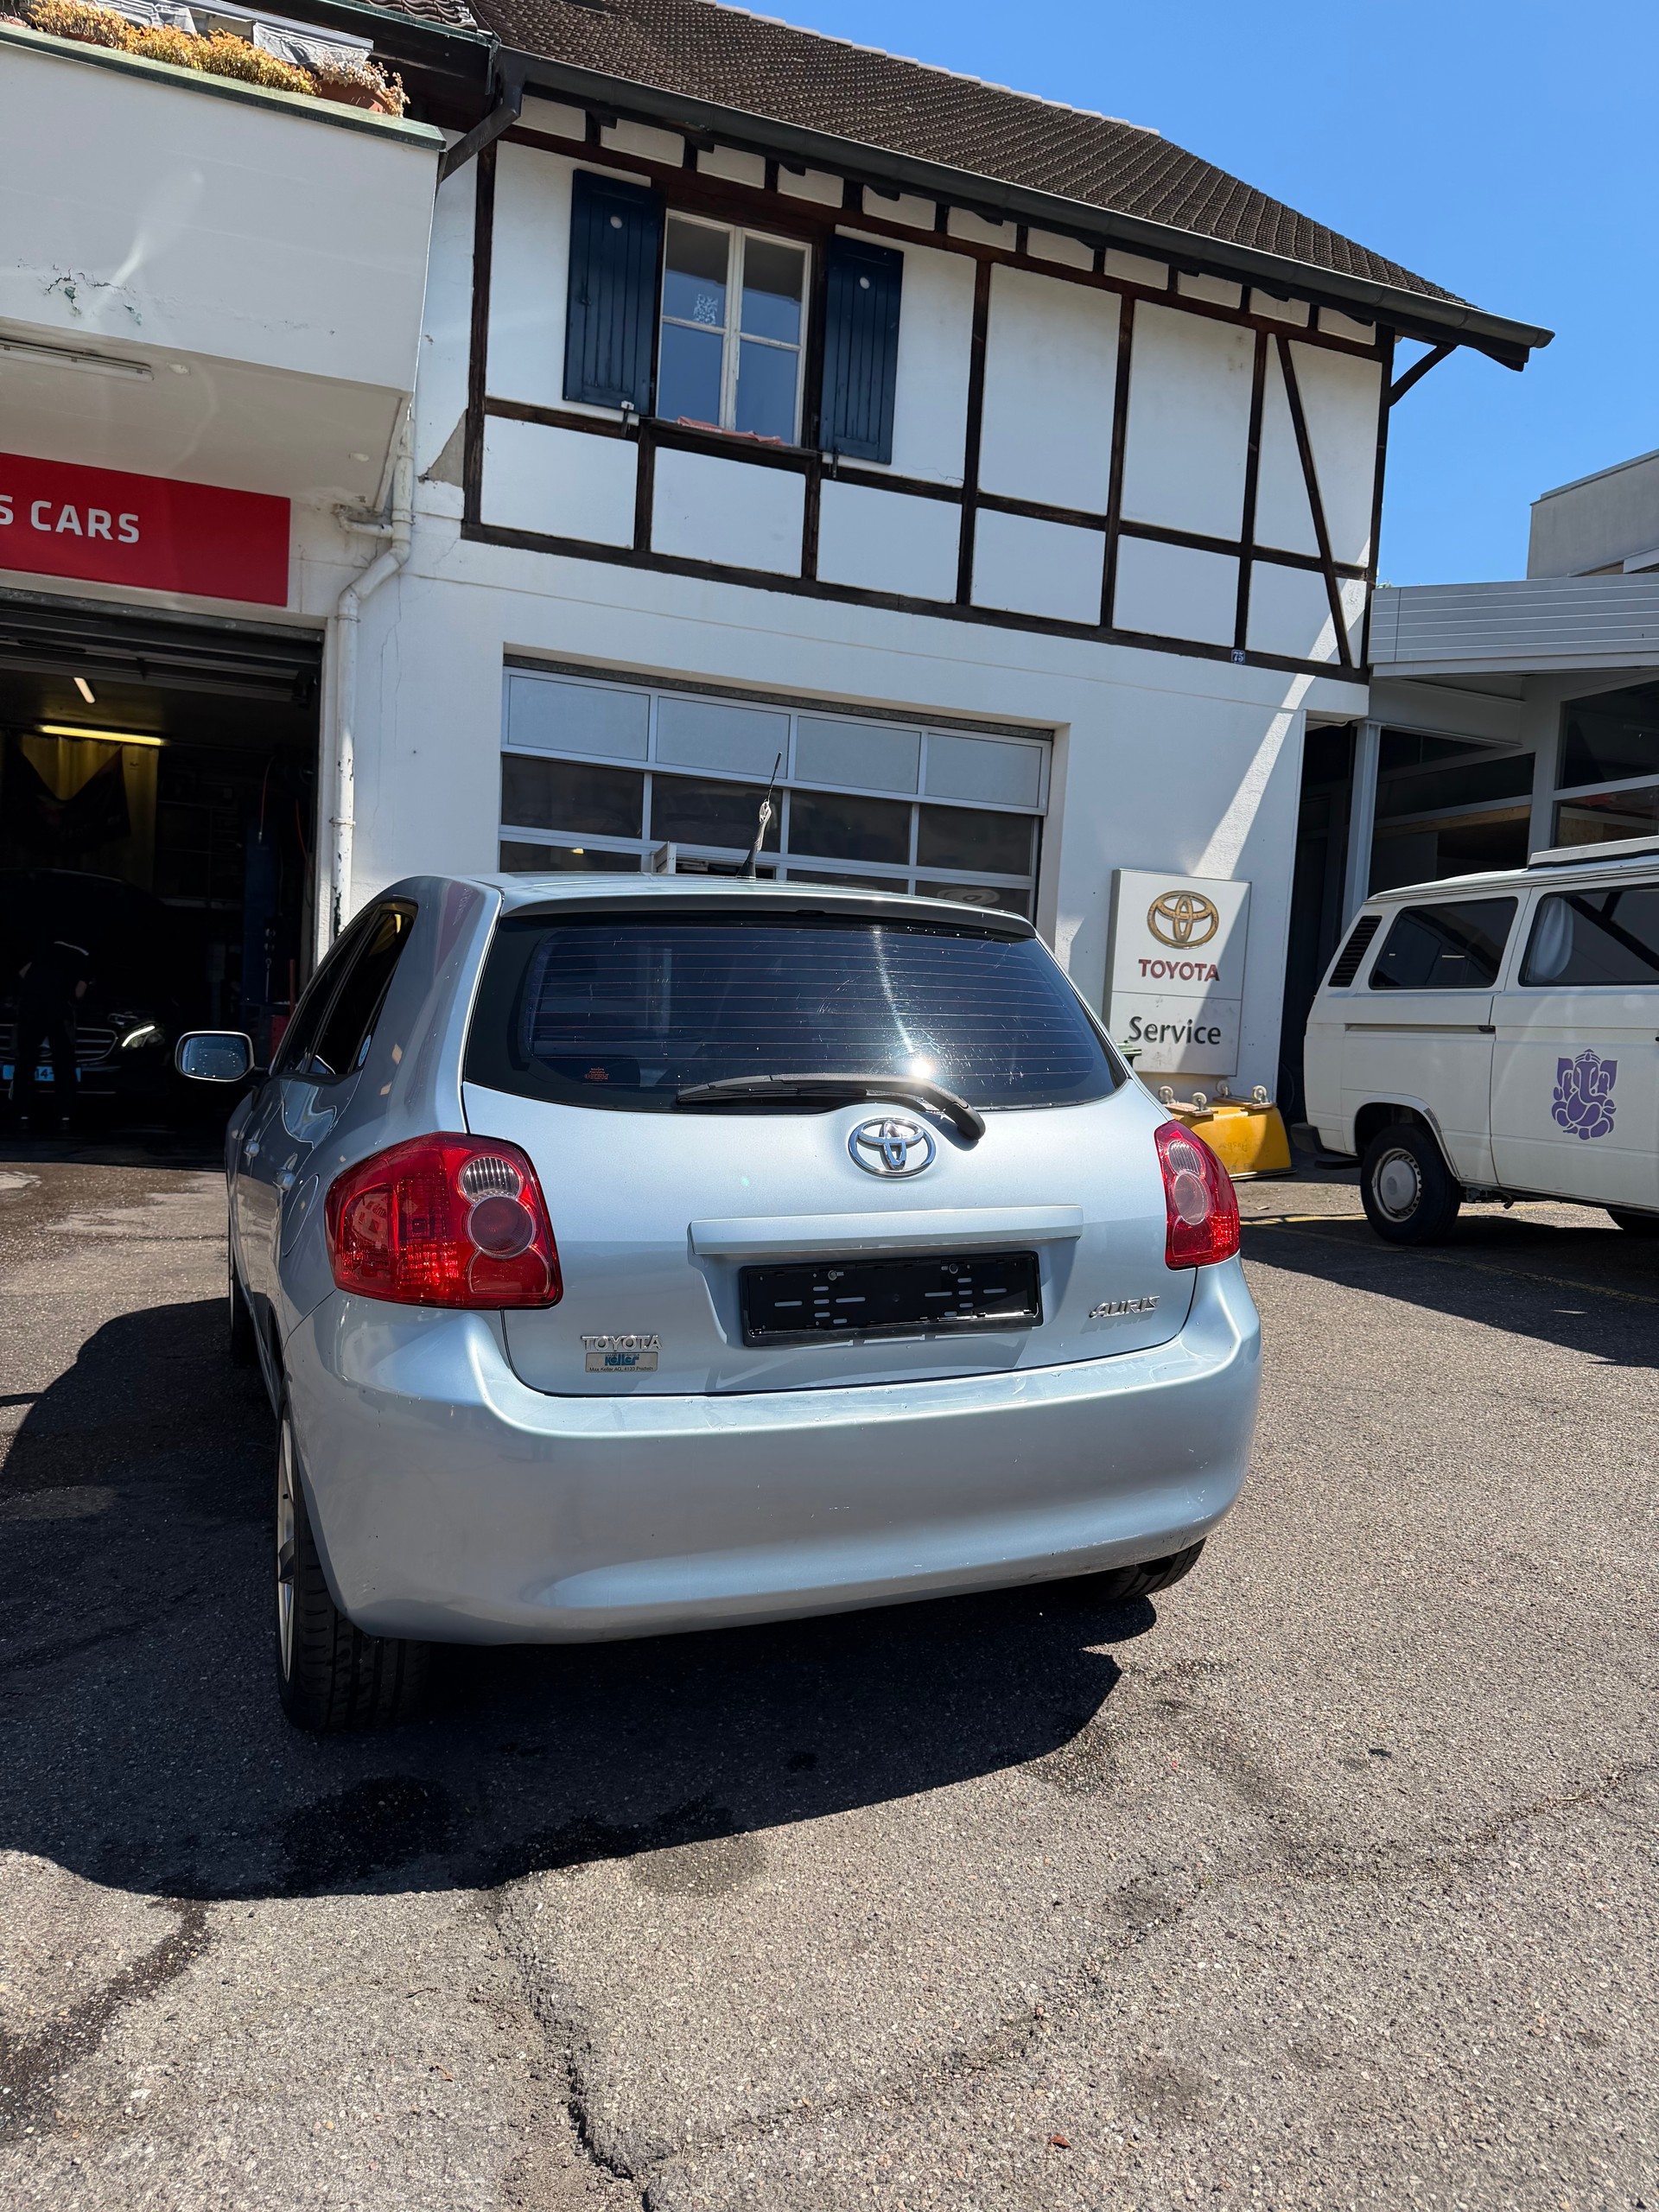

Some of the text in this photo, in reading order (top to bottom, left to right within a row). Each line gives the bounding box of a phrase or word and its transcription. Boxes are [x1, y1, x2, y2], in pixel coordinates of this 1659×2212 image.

[30, 500, 139, 543] CARS
[1233, 651, 1243, 663] 75
[1138, 958, 1220, 982] TOYOTA
[1128, 1015, 1222, 1045] Service
[1089, 1295, 1160, 1319] AURIS
[581, 1334, 662, 1351] TOYOTA
